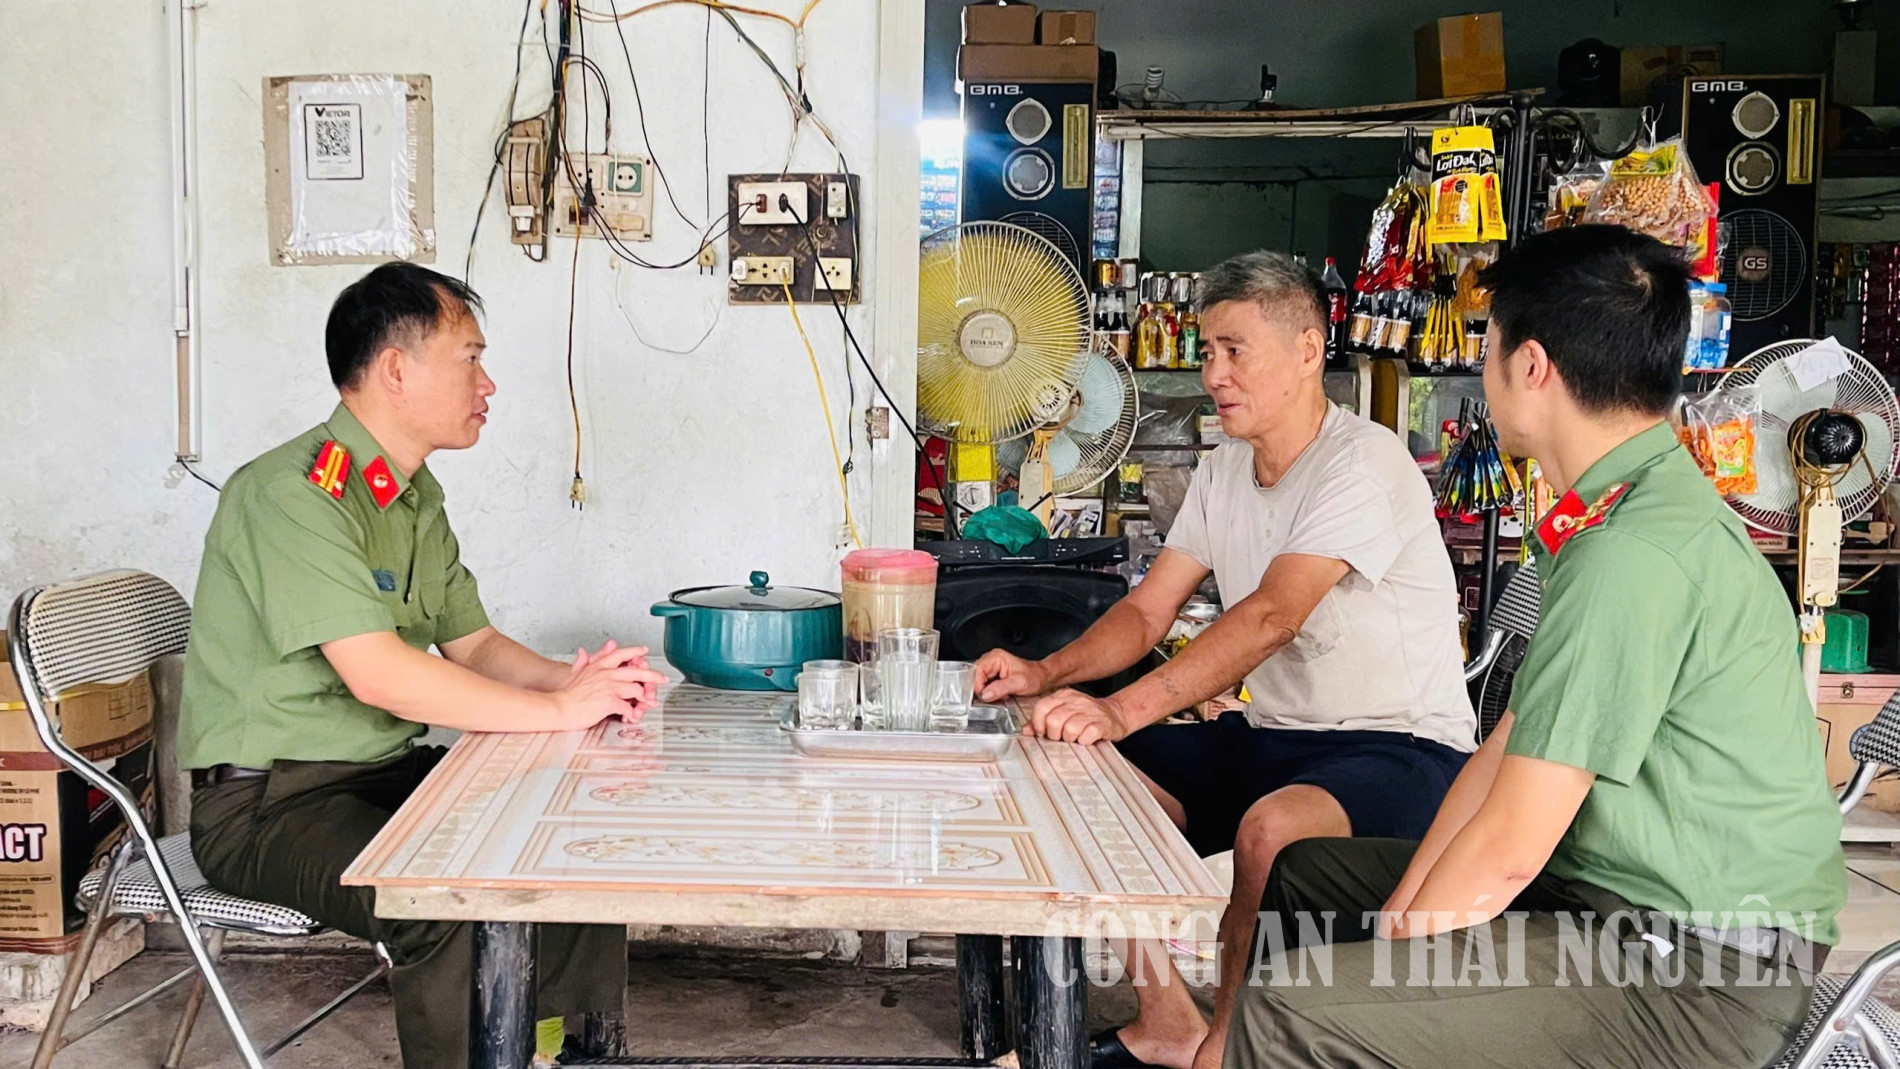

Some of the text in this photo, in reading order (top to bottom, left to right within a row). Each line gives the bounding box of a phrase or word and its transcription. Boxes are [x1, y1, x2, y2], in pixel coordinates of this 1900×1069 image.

[970, 84, 1020, 95] BMB
[1692, 81, 1744, 92] BMB
[1744, 257, 1767, 270] GS
